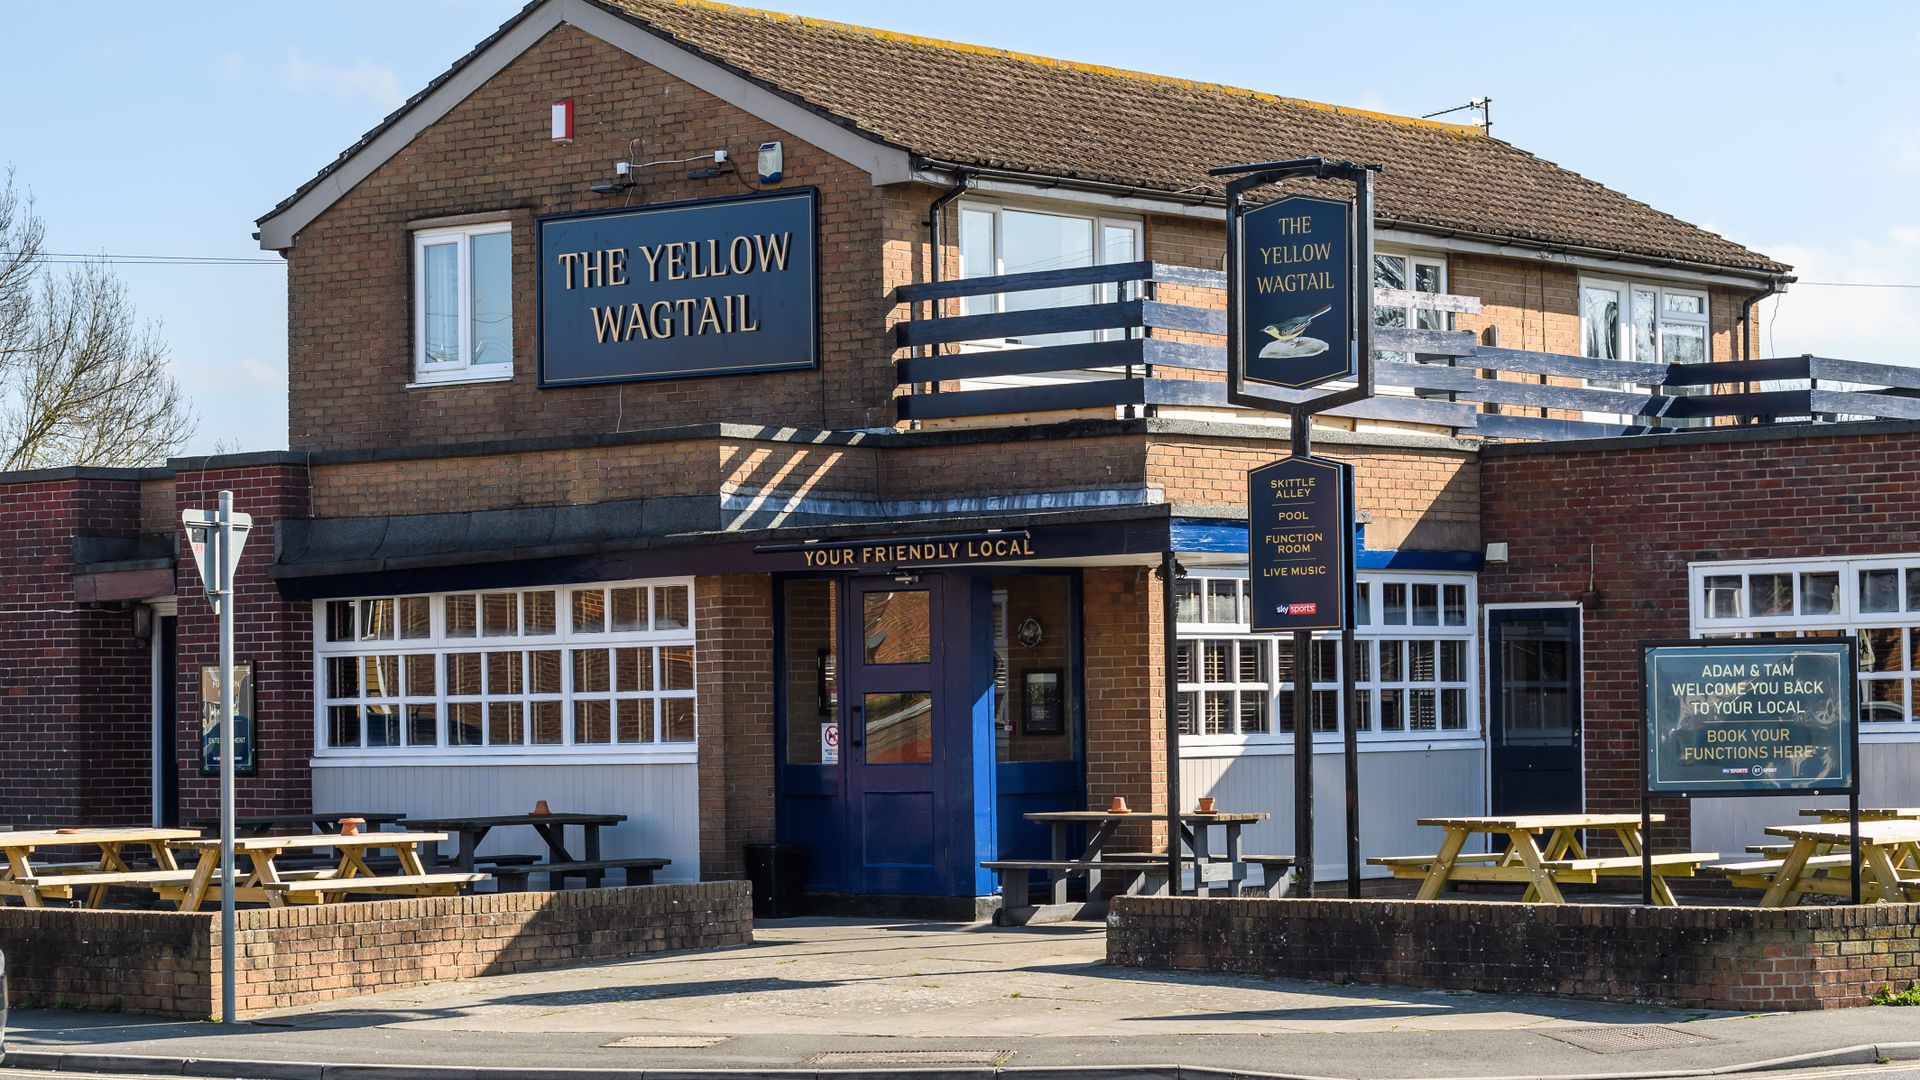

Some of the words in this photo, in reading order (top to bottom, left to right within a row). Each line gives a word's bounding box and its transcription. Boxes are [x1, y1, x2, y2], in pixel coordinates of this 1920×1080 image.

[1278, 216, 1312, 235] THE
[558, 248, 627, 290] THE
[639, 231, 790, 282] YELLOW
[1260, 242, 1331, 265] YELLOW
[1256, 272, 1335, 294] WAGTAIL
[590, 294, 759, 343] WAGTAIL
[1270, 477, 1316, 488] SKITTLE
[1275, 488, 1311, 498] ALLEY
[1278, 511, 1309, 521] POOL
[1265, 533, 1323, 544] FUNCTION
[804, 549, 854, 567] YOUR
[863, 542, 959, 564] FRIENDLY
[968, 539, 1034, 558] LOCAL
[1277, 544, 1311, 554] ROOM
[1263, 567, 1288, 577] LIVE
[1291, 565, 1326, 576] MUSIC
[1276, 606, 1289, 615] sky
[1290, 605, 1315, 614] sports
[1701, 664, 1745, 678] ADAM
[1749, 664, 1760, 677] &
[1763, 663, 1794, 677] TAM
[1671, 682, 1746, 696] WELCOME
[1750, 682, 1779, 695] YOU
[1783, 680, 1824, 694] BACK
[1691, 701, 1710, 715] TO
[1713, 701, 1753, 715] YOUR
[1757, 700, 1806, 714] LOCAL
[1707, 729, 1747, 743] BOOK
[1751, 728, 1790, 742] YOUR
[1684, 746, 1769, 760] FUNCTIONS
[1773, 745, 1814, 759] HERE
